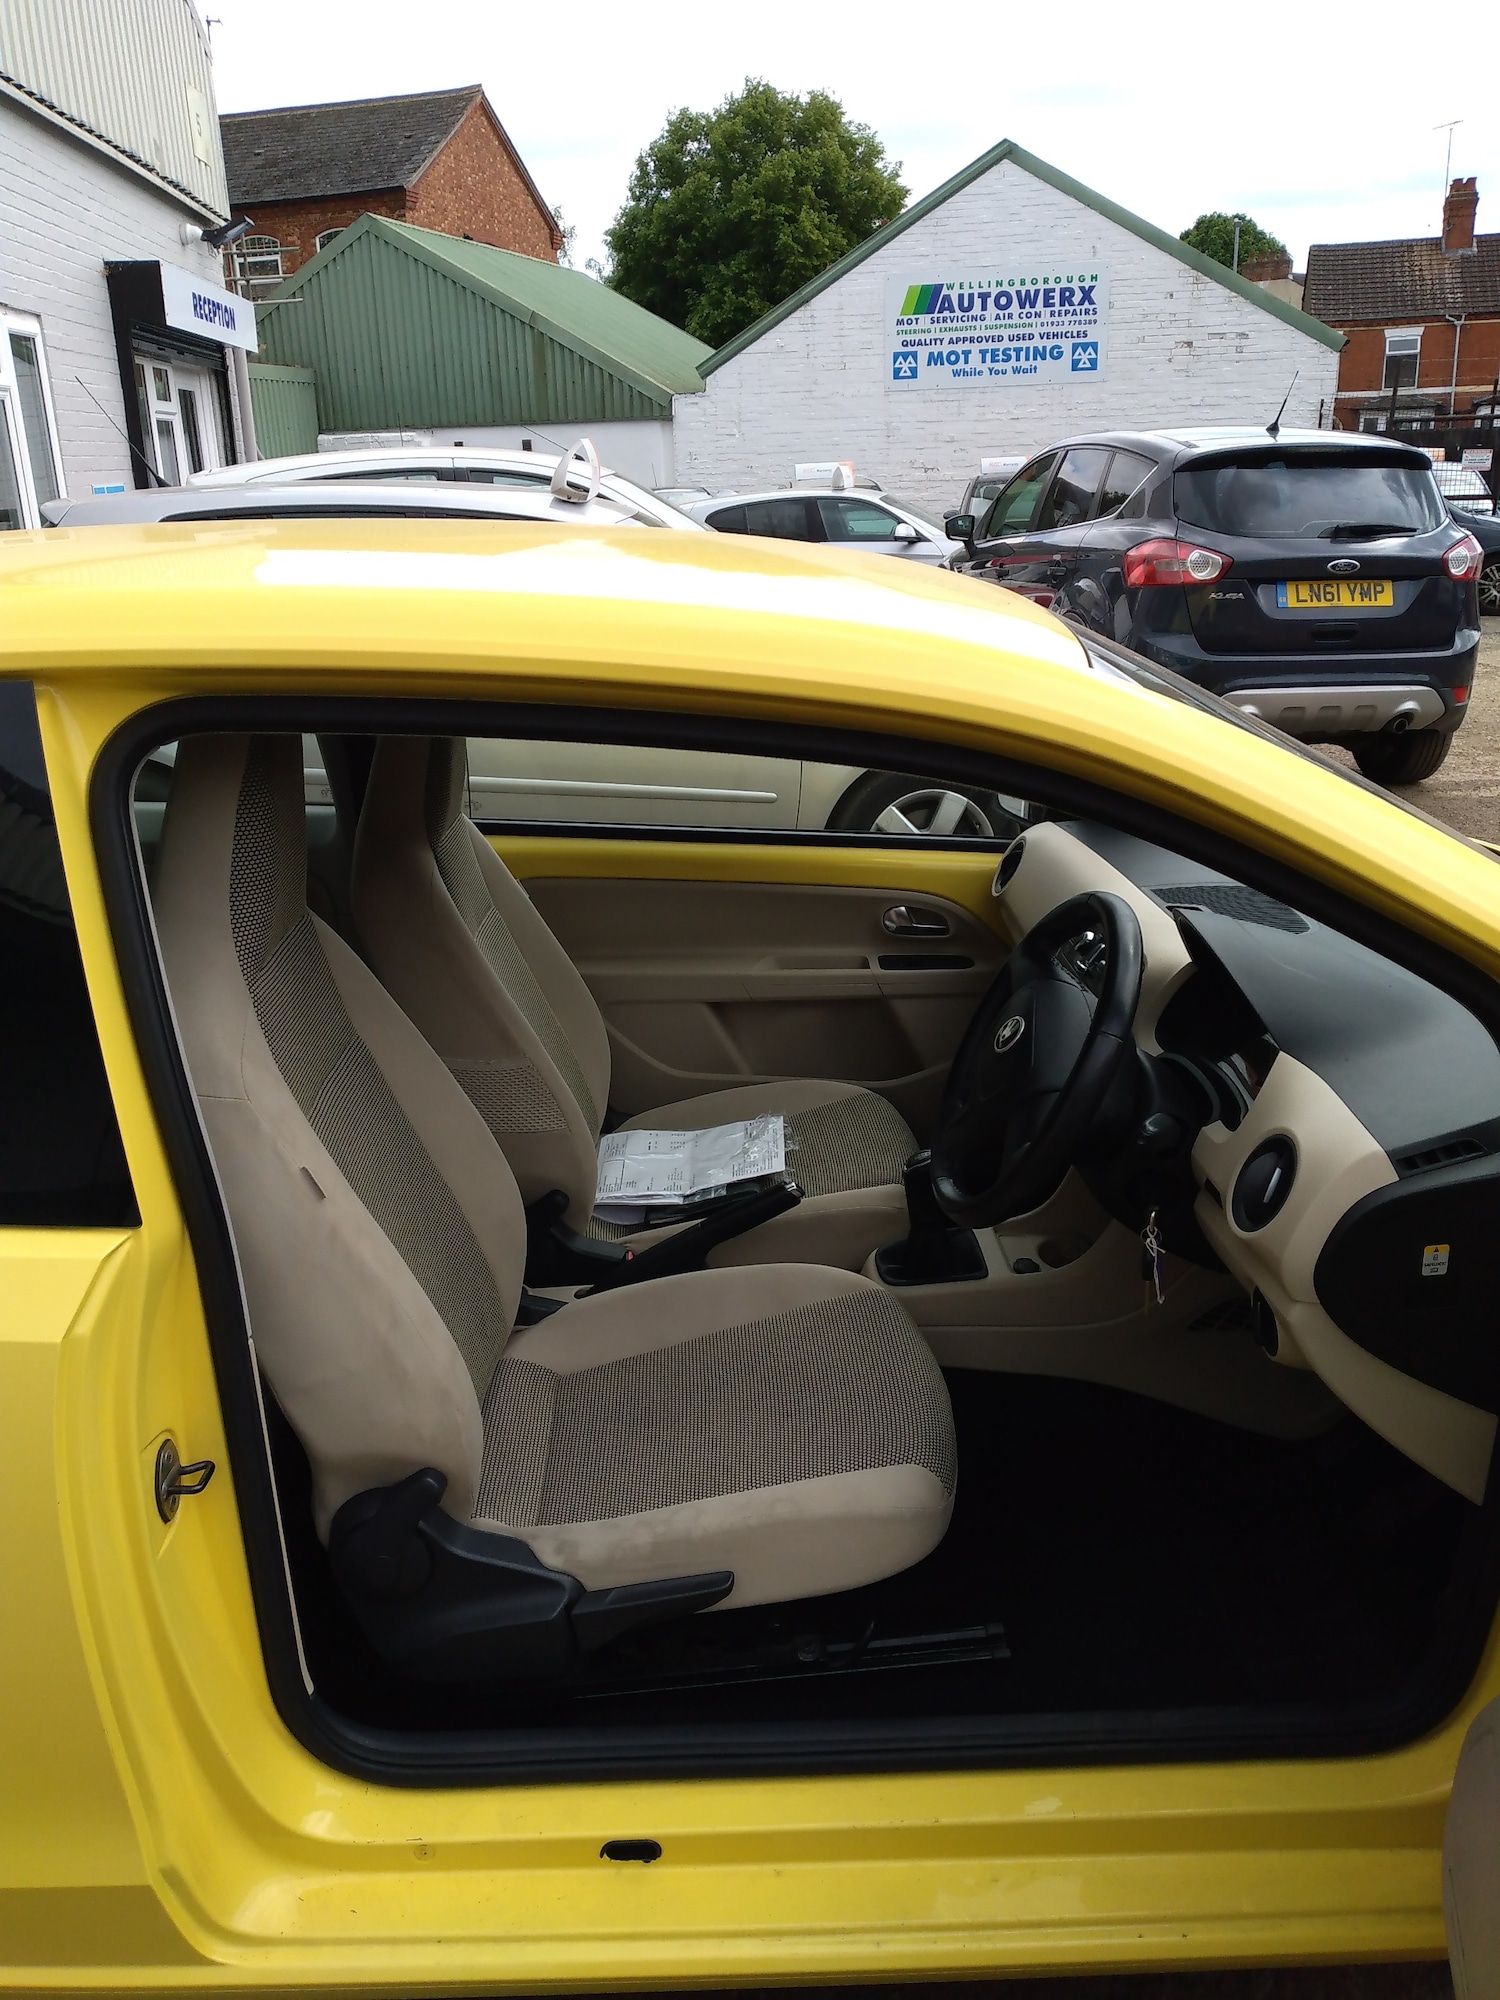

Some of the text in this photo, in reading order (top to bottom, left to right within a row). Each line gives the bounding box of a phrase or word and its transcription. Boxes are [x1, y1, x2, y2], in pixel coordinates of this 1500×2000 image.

[946, 273, 1098, 291] WELLINGBOROUGH
[937, 285, 1096, 314] AUTOWERX
[192, 291, 236, 332] RECEPTION
[896, 307, 1098, 326] MOT SERVICING AIR CON REPAIRS
[896, 319, 1098, 336] STEERING EXHAUSTS SUSPENSION 01933 778389
[901, 329, 1088, 348] QUALITY APPROVED USED VEHICLES
[926, 344, 1064, 367] MOT TESTING
[951, 364, 1038, 378] While You Wait
[1296, 583, 1385, 603] LN61 YMP
